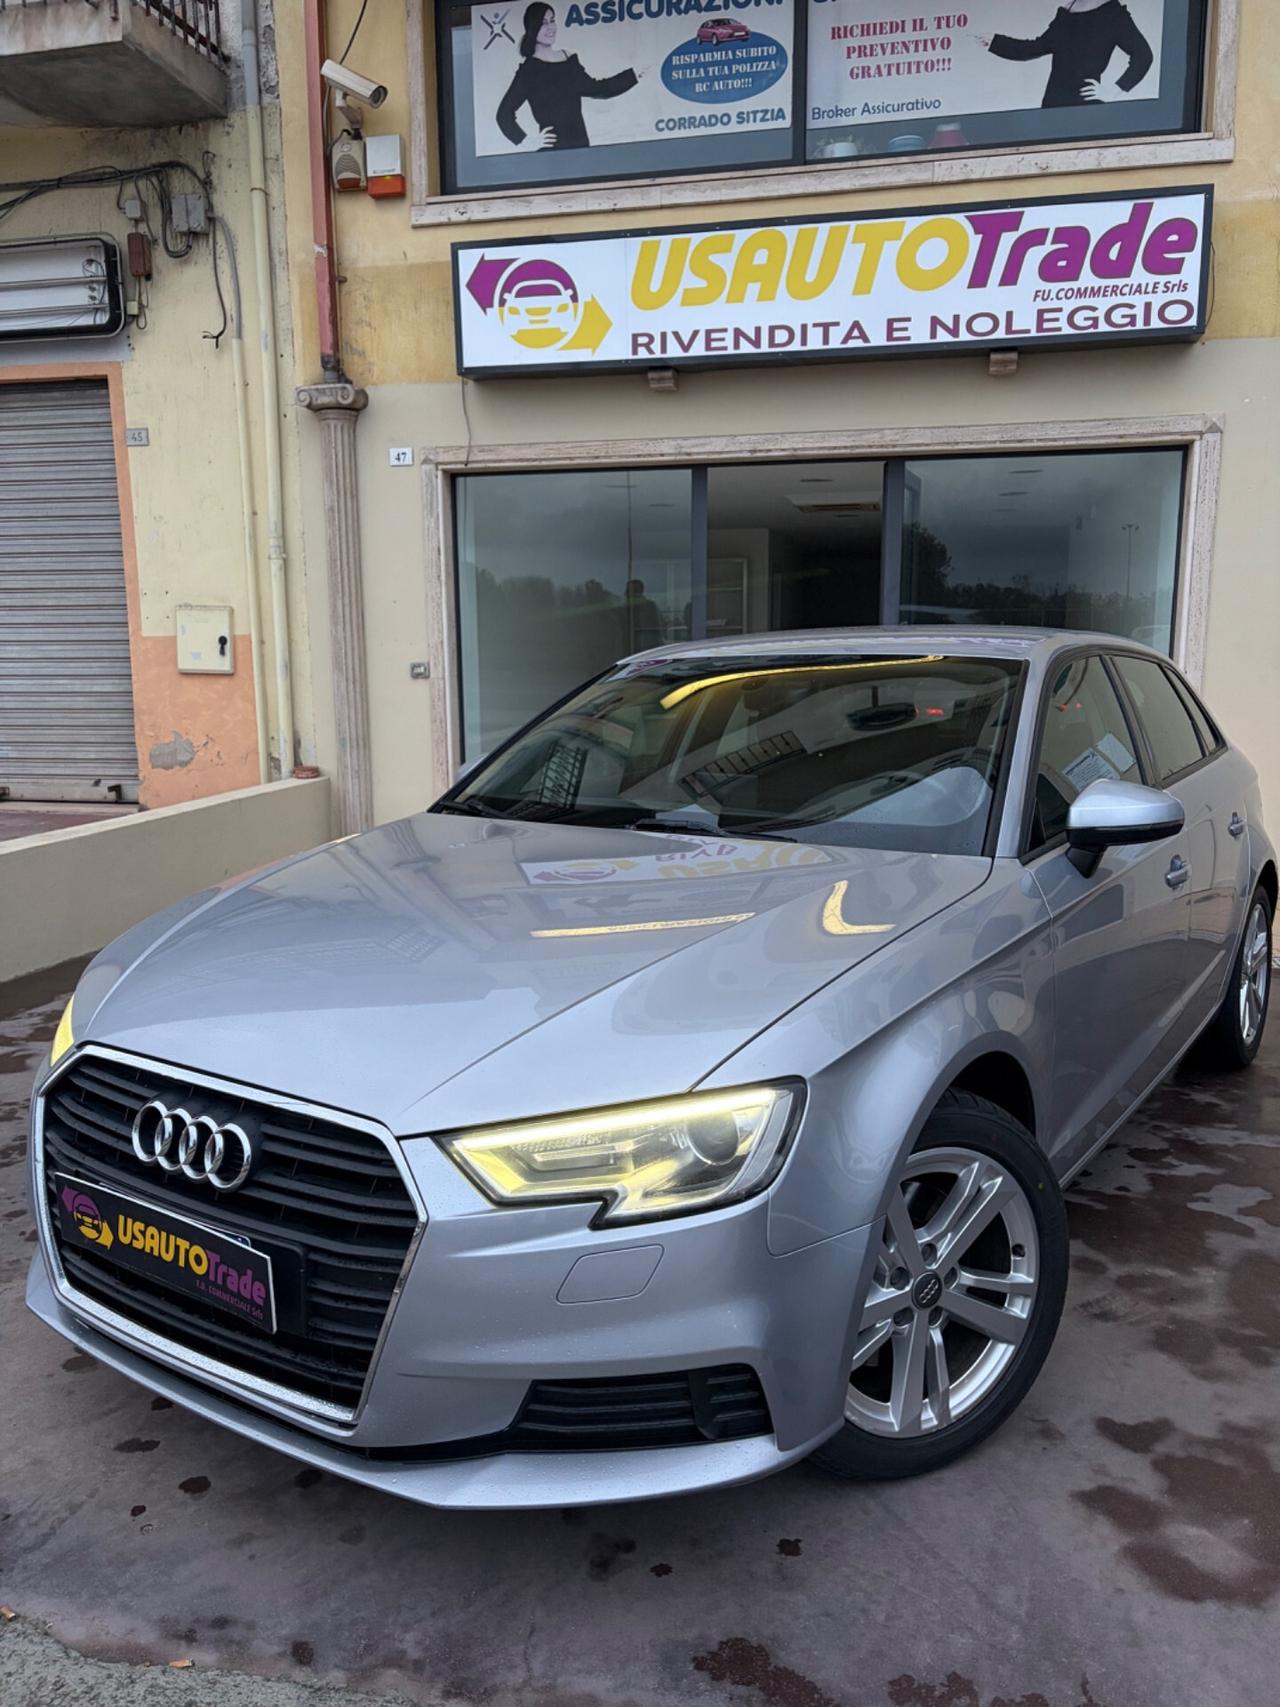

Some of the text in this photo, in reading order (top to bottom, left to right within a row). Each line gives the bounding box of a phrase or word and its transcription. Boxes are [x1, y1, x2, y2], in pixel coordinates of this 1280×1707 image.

[565, 0, 784, 28] ASSICURAZ
[831, 13, 969, 41] RICHIEDI IL TUO
[672, 45, 777, 66] RISPARMIA SUBITO
[845, 36, 952, 60] PREVENTIVO
[672, 60, 777, 81] SULLA TUA POLIZZA
[849, 57, 953, 81] GRATUITO!!!
[695, 77, 753, 93] RC AUTO!!!
[655, 107, 787, 133] CORRADO SITZIA
[811, 97, 942, 121] Broker Assicurativo
[1161, 279, 1189, 294] Srls
[630, 298, 1195, 357] RIVENDITA E NOLEGGIO
[394, 451, 407, 463] 47
